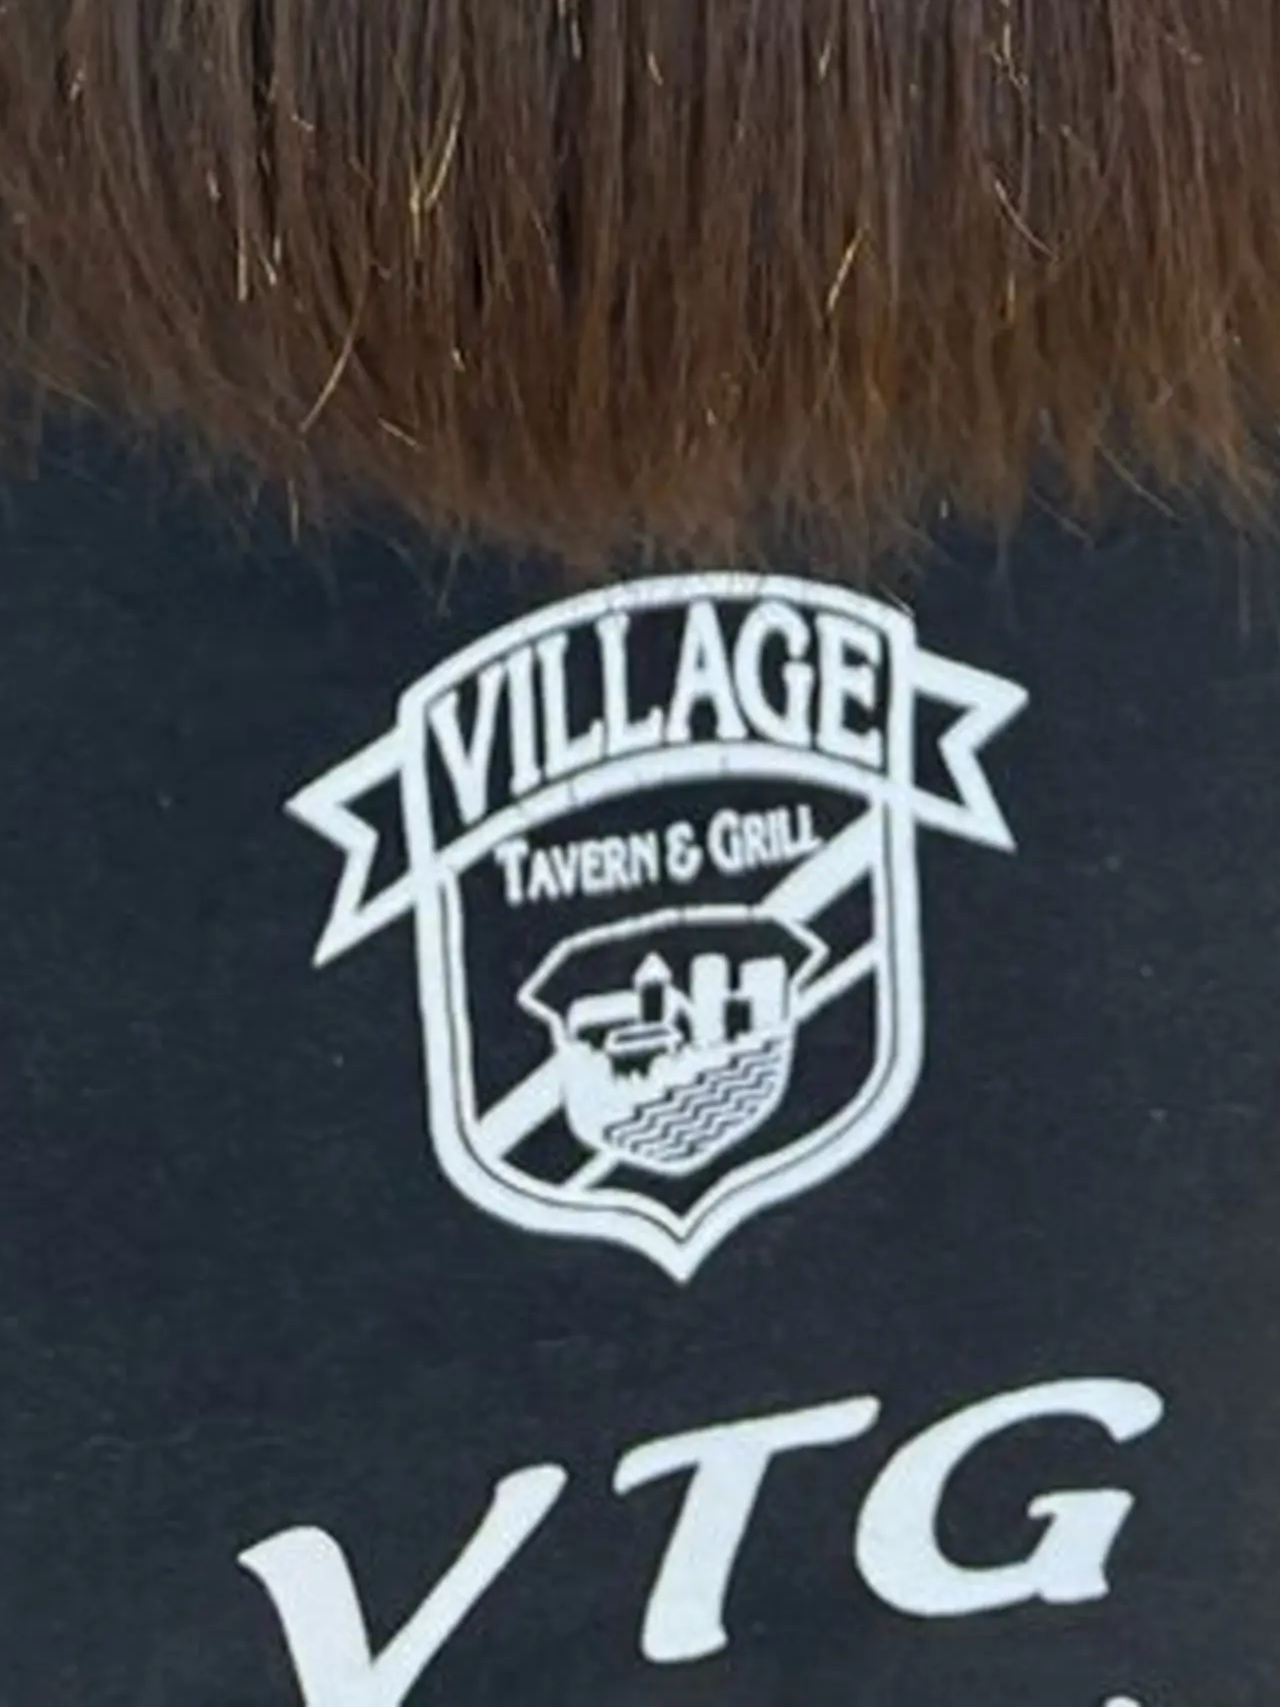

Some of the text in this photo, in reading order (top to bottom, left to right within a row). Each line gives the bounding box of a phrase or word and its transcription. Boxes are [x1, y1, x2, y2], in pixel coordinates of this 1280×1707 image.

[428, 599, 884, 823] VILLAGE
[665, 820, 703, 882] &
[238, 1378, 1163, 1707] VTG
